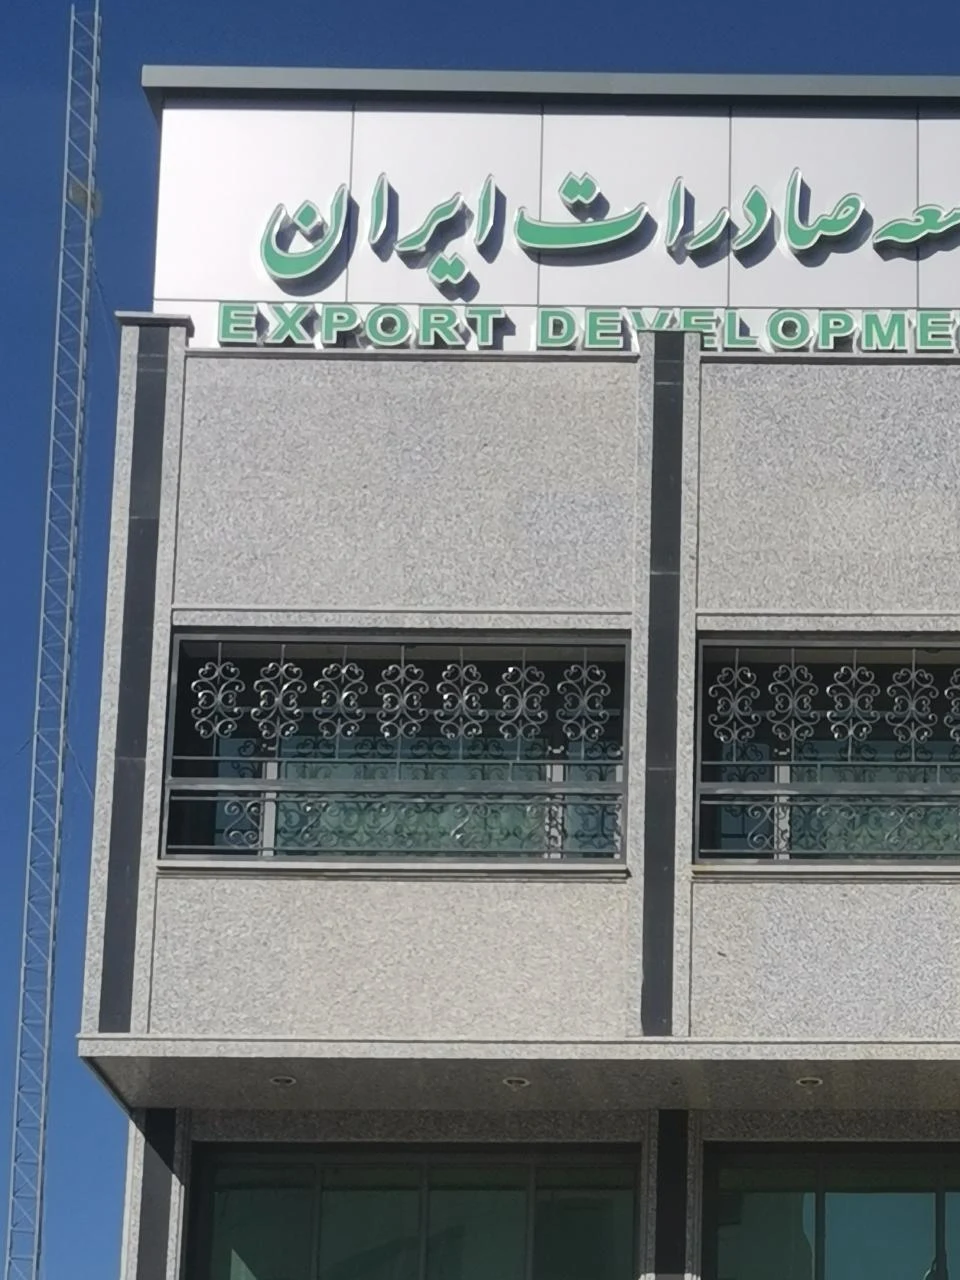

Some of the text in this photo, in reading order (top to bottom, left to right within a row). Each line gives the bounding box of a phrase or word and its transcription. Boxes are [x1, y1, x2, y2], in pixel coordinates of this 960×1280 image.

[260, 170, 496, 286] ایران
[513, 166, 867, 253] صادرات
[217, 301, 506, 347] EXPORT
